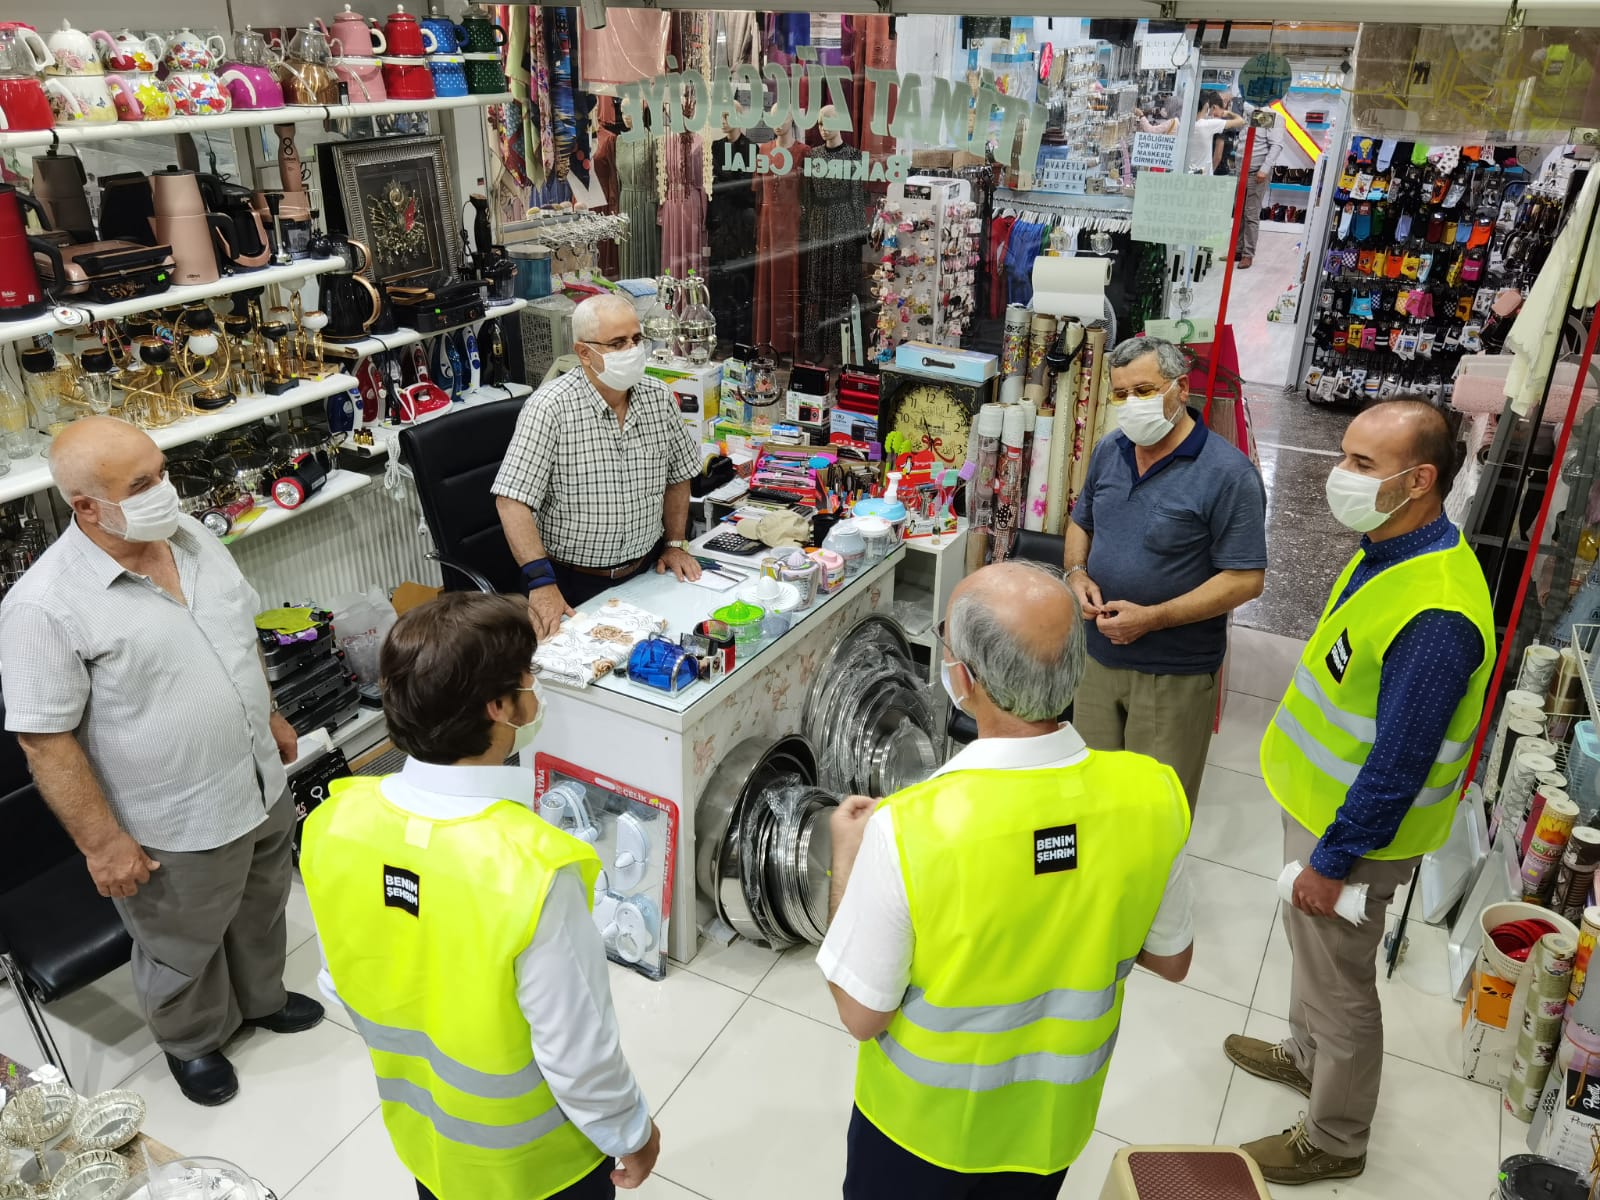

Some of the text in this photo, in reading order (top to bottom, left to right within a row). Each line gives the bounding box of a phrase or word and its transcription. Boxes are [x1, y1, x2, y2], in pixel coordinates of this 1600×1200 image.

[926, 392, 936, 404] 12
[956, 444, 963, 455] 3
[1036, 833, 1075, 851] BENİM
[1036, 847, 1076, 864] ŞEHRİM
[385, 874, 418, 894] BENİM
[386, 886, 418, 906] ŞEHRİM
